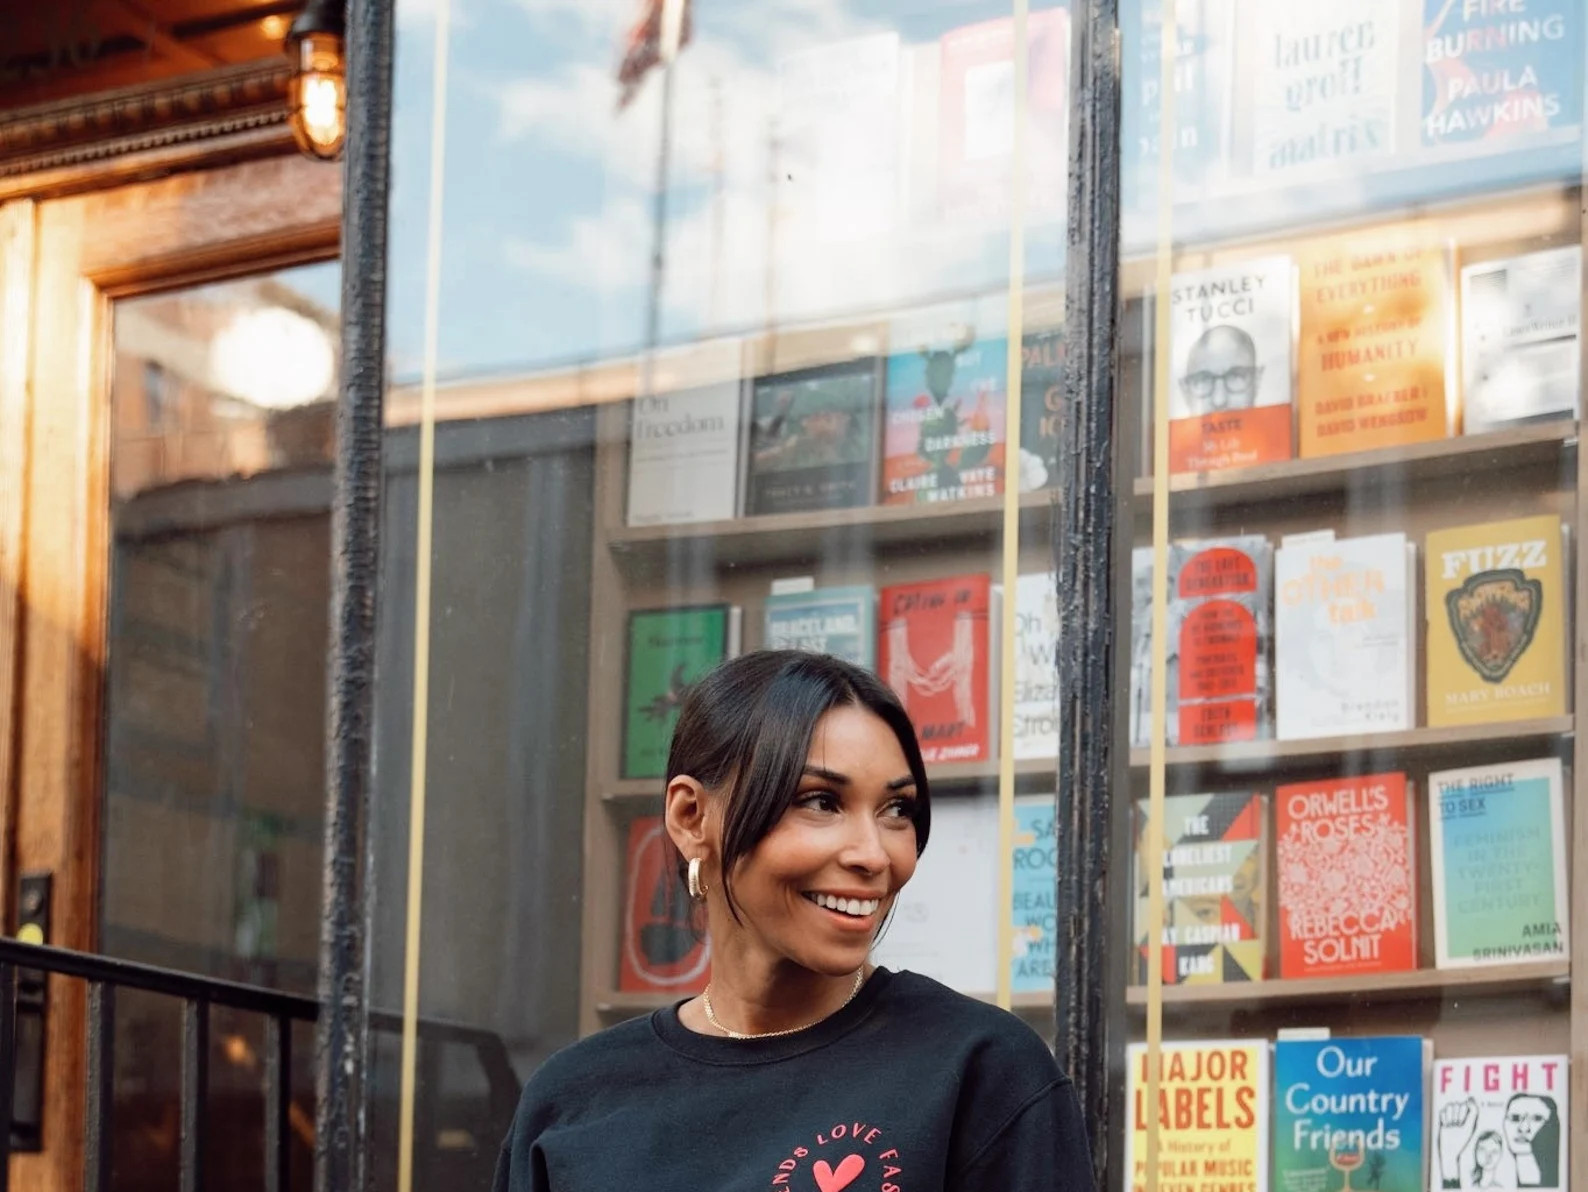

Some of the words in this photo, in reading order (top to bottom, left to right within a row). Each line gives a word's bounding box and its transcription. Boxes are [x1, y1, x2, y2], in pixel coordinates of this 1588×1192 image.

[1274, 20, 1376, 68] lauren
[1426, 12, 1565, 64] BURNING
[1448, 64, 1538, 101] PAULA
[1427, 91, 1562, 138] HAWKINS
[1172, 274, 1266, 305] STANLEY
[1316, 271, 1422, 303] EVERYTHING
[1187, 298, 1255, 323] TUCCI
[1321, 337, 1420, 372] HUMANITY
[1441, 539, 1548, 580] FUZZ
[1445, 686, 1491, 706] MARY
[1495, 681, 1551, 702] ROACH
[1438, 778, 1463, 795] THE
[1469, 772, 1515, 792] RIGHT
[1288, 785, 1389, 820] ORWELL'S
[1459, 796, 1486, 813] SEX
[1183, 815, 1210, 835] THE
[1301, 812, 1376, 845] ROSES
[1289, 909, 1398, 941] REBECCA
[1522, 922, 1562, 938] AMIA
[1179, 954, 1215, 976] KANG
[1304, 934, 1382, 965] SOLNIT
[1473, 942, 1564, 962] SRINIVASAN
[1316, 1046, 1378, 1079] Our
[1440, 1062, 1558, 1094] FIGHT
[1135, 1086, 1256, 1131] LABELS
[1285, 1083, 1410, 1121] Country
[817, 1122, 882, 1145] LOVE
[1294, 1117, 1401, 1152] Friends
[1136, 1160, 1197, 1177] PULAR
[1204, 1159, 1252, 1177] MUSIC
